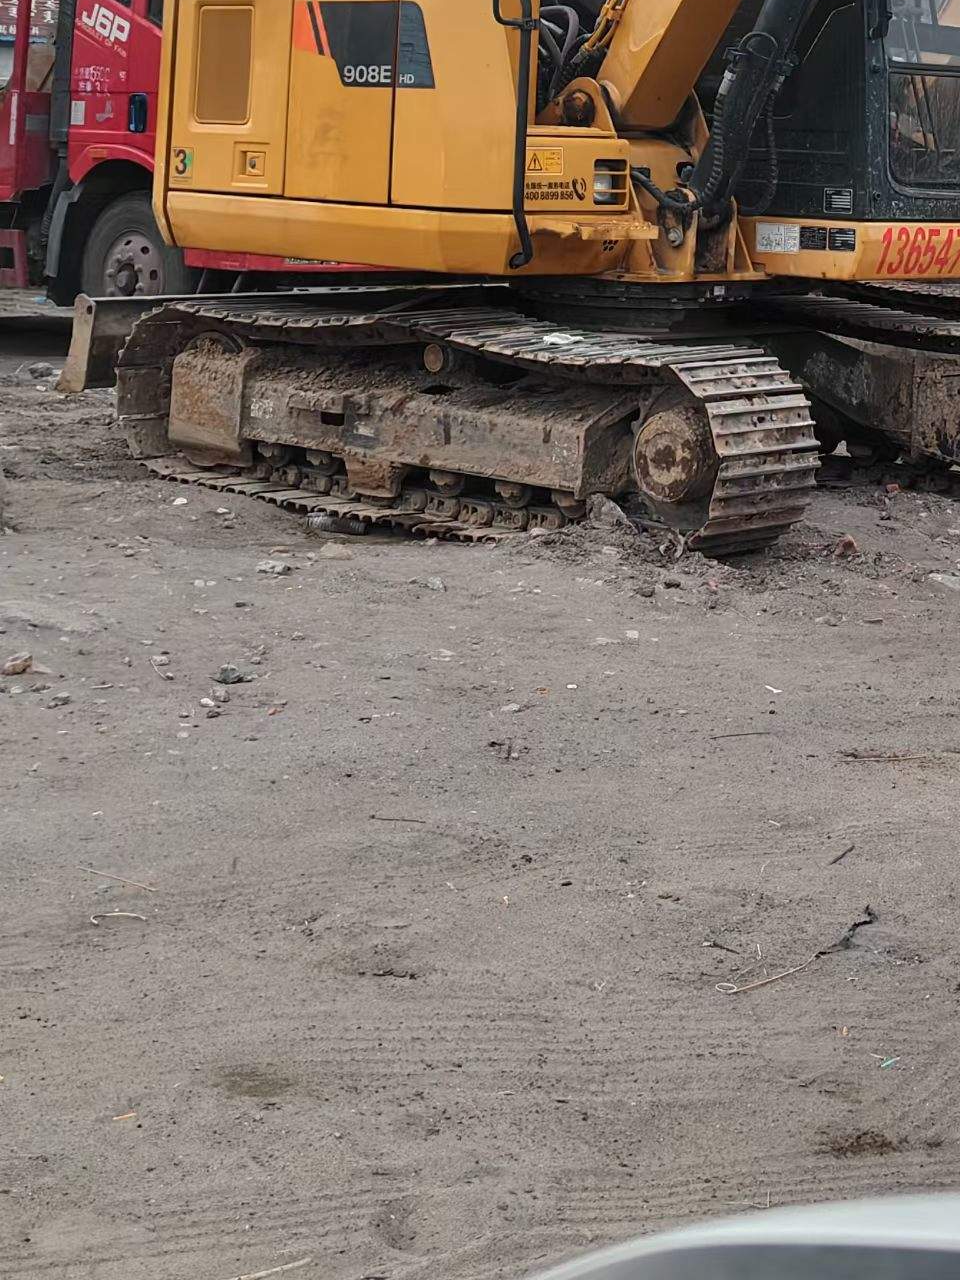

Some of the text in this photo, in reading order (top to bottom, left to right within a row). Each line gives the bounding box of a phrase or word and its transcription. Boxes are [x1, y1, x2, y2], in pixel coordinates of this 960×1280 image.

[81, 3, 131, 43] J6P
[343, 65, 415, 84] 908E HD
[175, 148, 187, 176] 3
